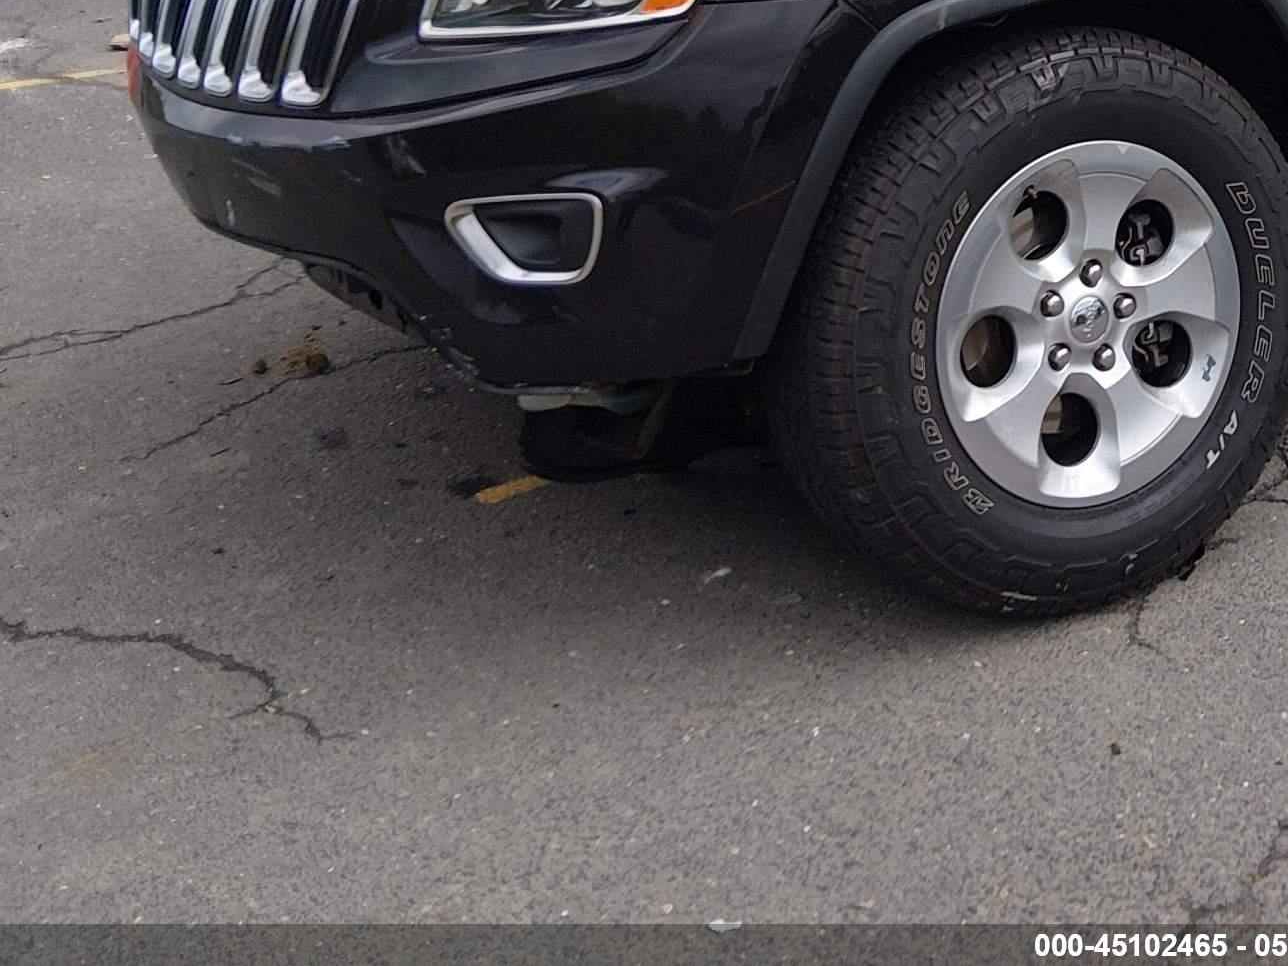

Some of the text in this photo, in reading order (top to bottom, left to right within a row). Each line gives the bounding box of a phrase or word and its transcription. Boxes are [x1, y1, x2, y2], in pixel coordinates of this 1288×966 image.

[911, 191, 995, 515] BRIDGESTONE
[1206, 182, 1276, 470] DUELER A/T
